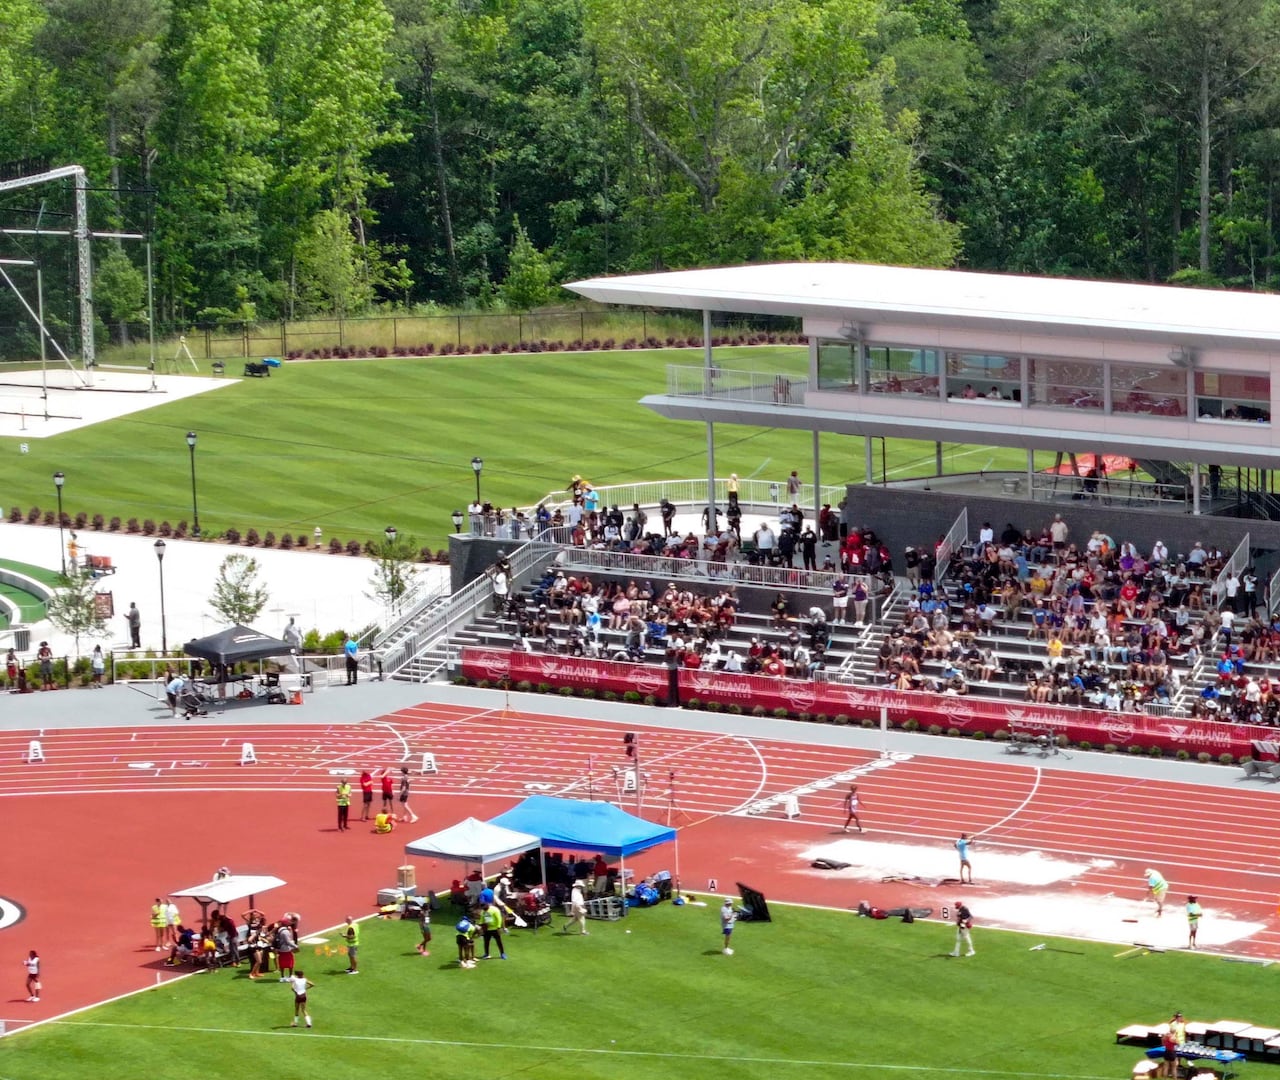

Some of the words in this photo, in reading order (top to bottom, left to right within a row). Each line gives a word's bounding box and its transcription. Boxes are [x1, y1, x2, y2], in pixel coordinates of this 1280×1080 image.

[561, 665, 598, 678] ATLANTA
[713, 680, 751, 693] ATLANTA
[869, 697, 907, 709] ATLANTA
[1027, 713, 1067, 726] ATLANTA
[1190, 729, 1231, 741] ATLANTA
